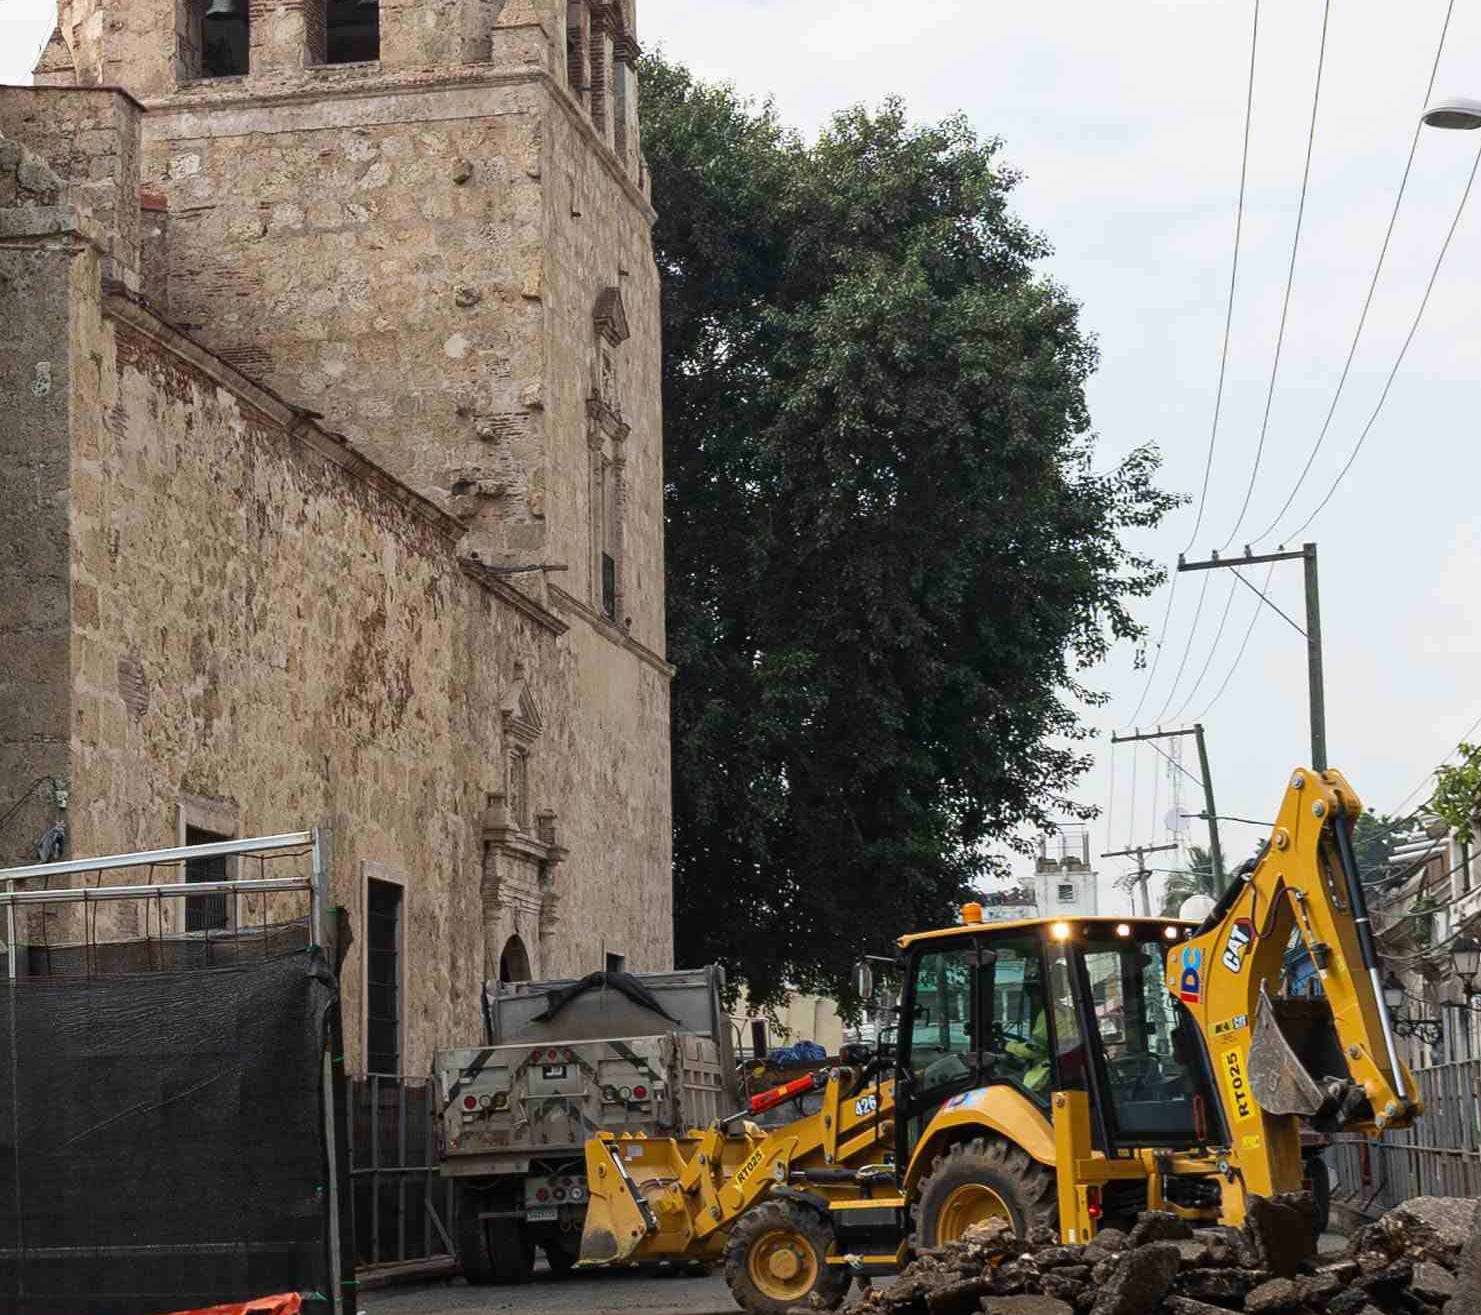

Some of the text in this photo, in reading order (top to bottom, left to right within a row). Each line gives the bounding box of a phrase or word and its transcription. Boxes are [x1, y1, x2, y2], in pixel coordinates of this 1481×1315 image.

[1222, 923, 1251, 974] CAT
[1180, 946, 1201, 1004] IDC
[854, 1094, 877, 1116] 426
[1226, 1051, 1251, 1118] RT025
[736, 1150, 764, 1185] RT025
